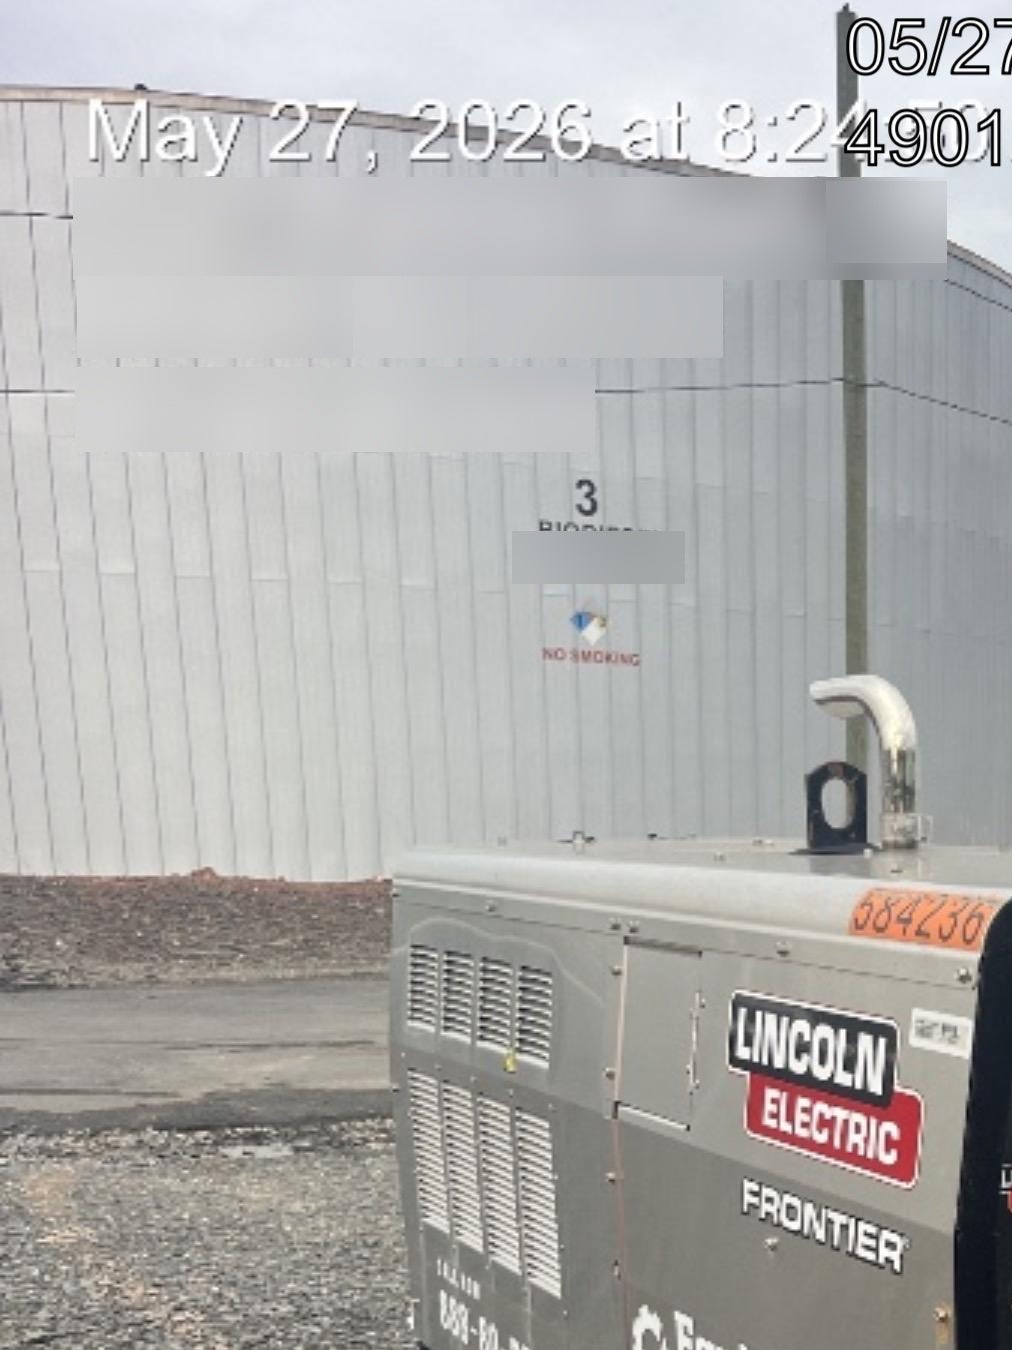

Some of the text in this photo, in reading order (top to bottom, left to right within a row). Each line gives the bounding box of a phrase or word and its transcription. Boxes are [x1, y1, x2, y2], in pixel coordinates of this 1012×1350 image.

[574, 478, 599, 517] 3
[542, 647, 641, 667] NO SMOKING
[733, 1006, 888, 1097] LINCOLN
[760, 1087, 902, 1167] ELECTRIC
[740, 1177, 906, 1276] FRONTIER
